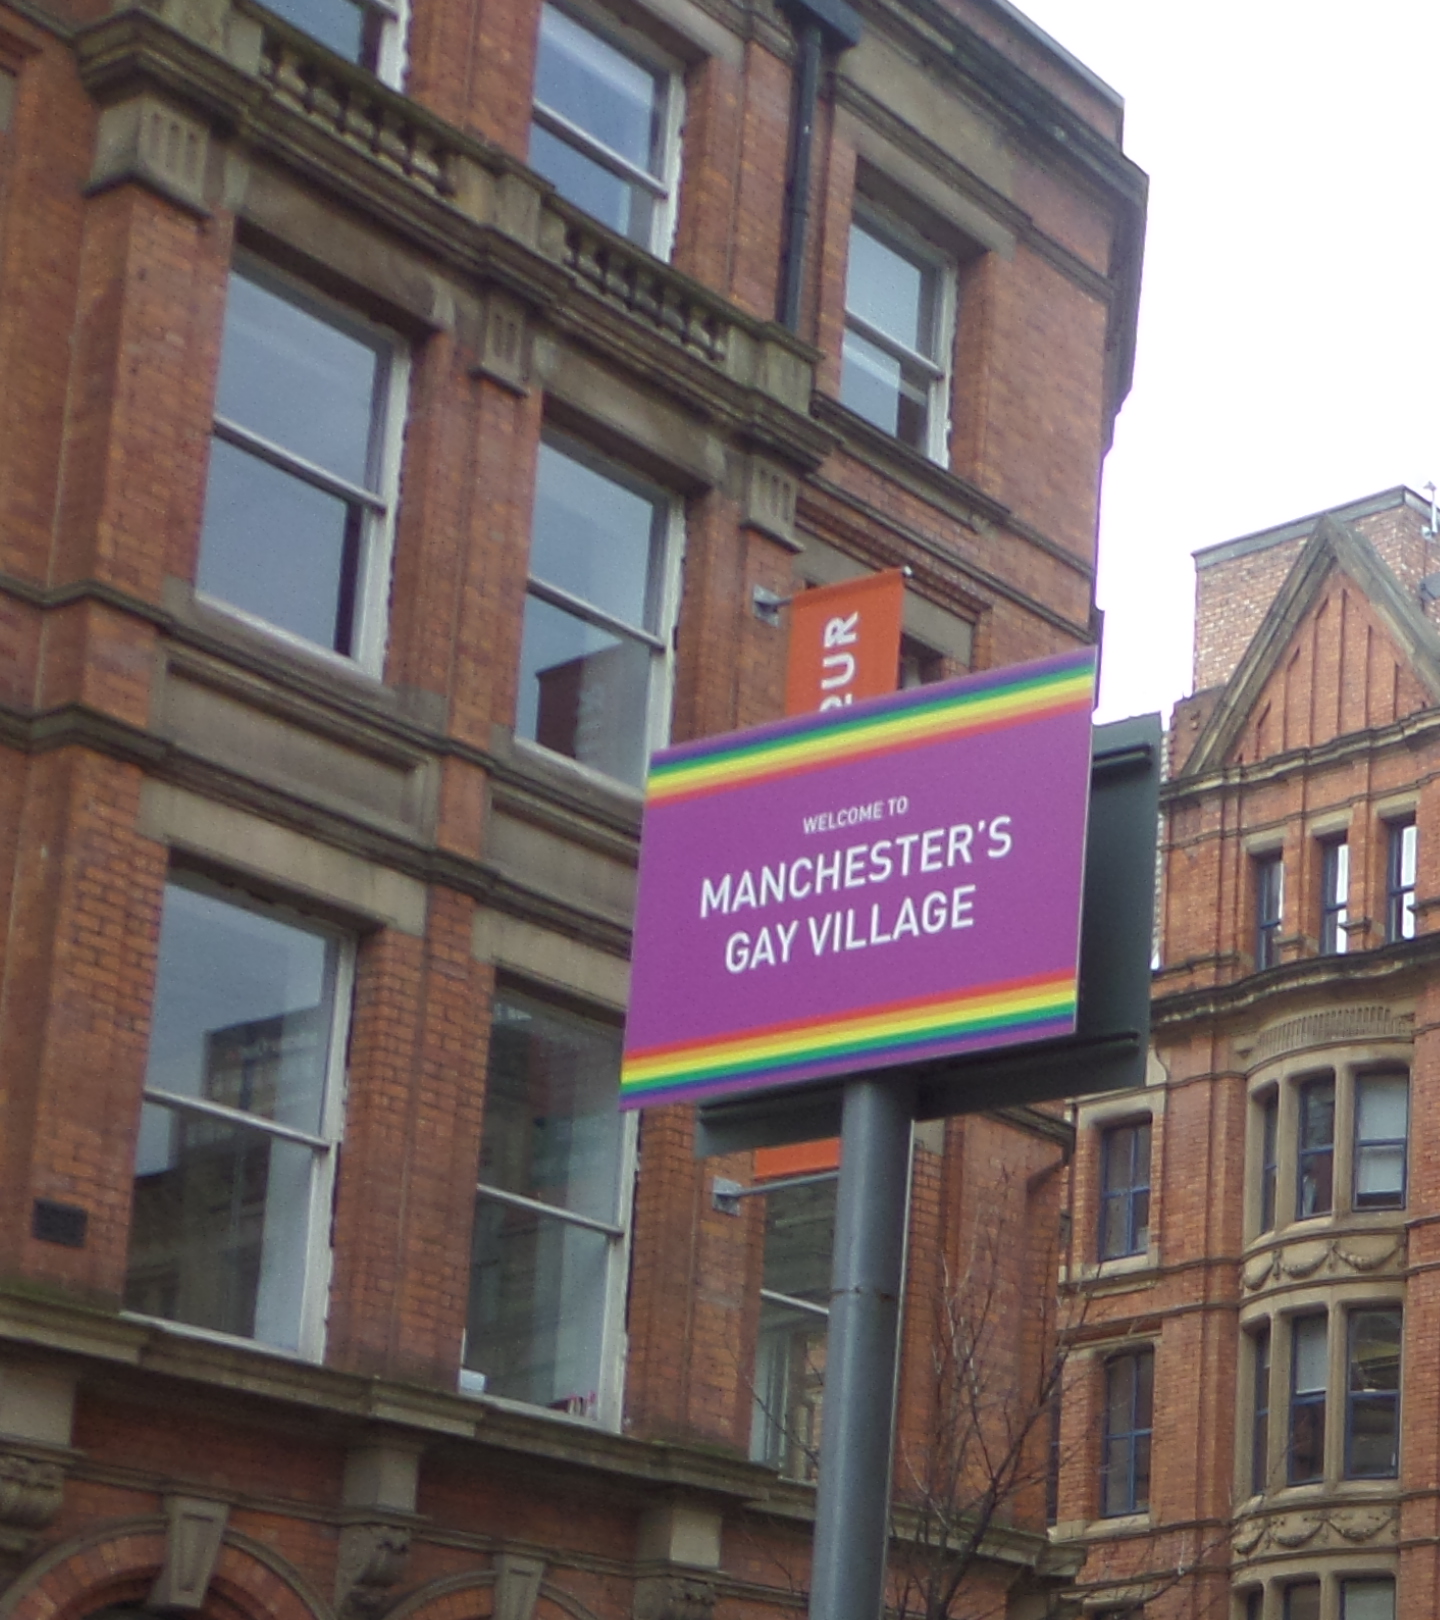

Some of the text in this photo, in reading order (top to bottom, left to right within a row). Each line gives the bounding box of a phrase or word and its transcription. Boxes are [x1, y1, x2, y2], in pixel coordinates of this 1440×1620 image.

[802, 796, 909, 834] WELCOME TO
[699, 815, 1012, 918] MANCHESTER'S
[724, 884, 977, 974] GAY VILLAGE
